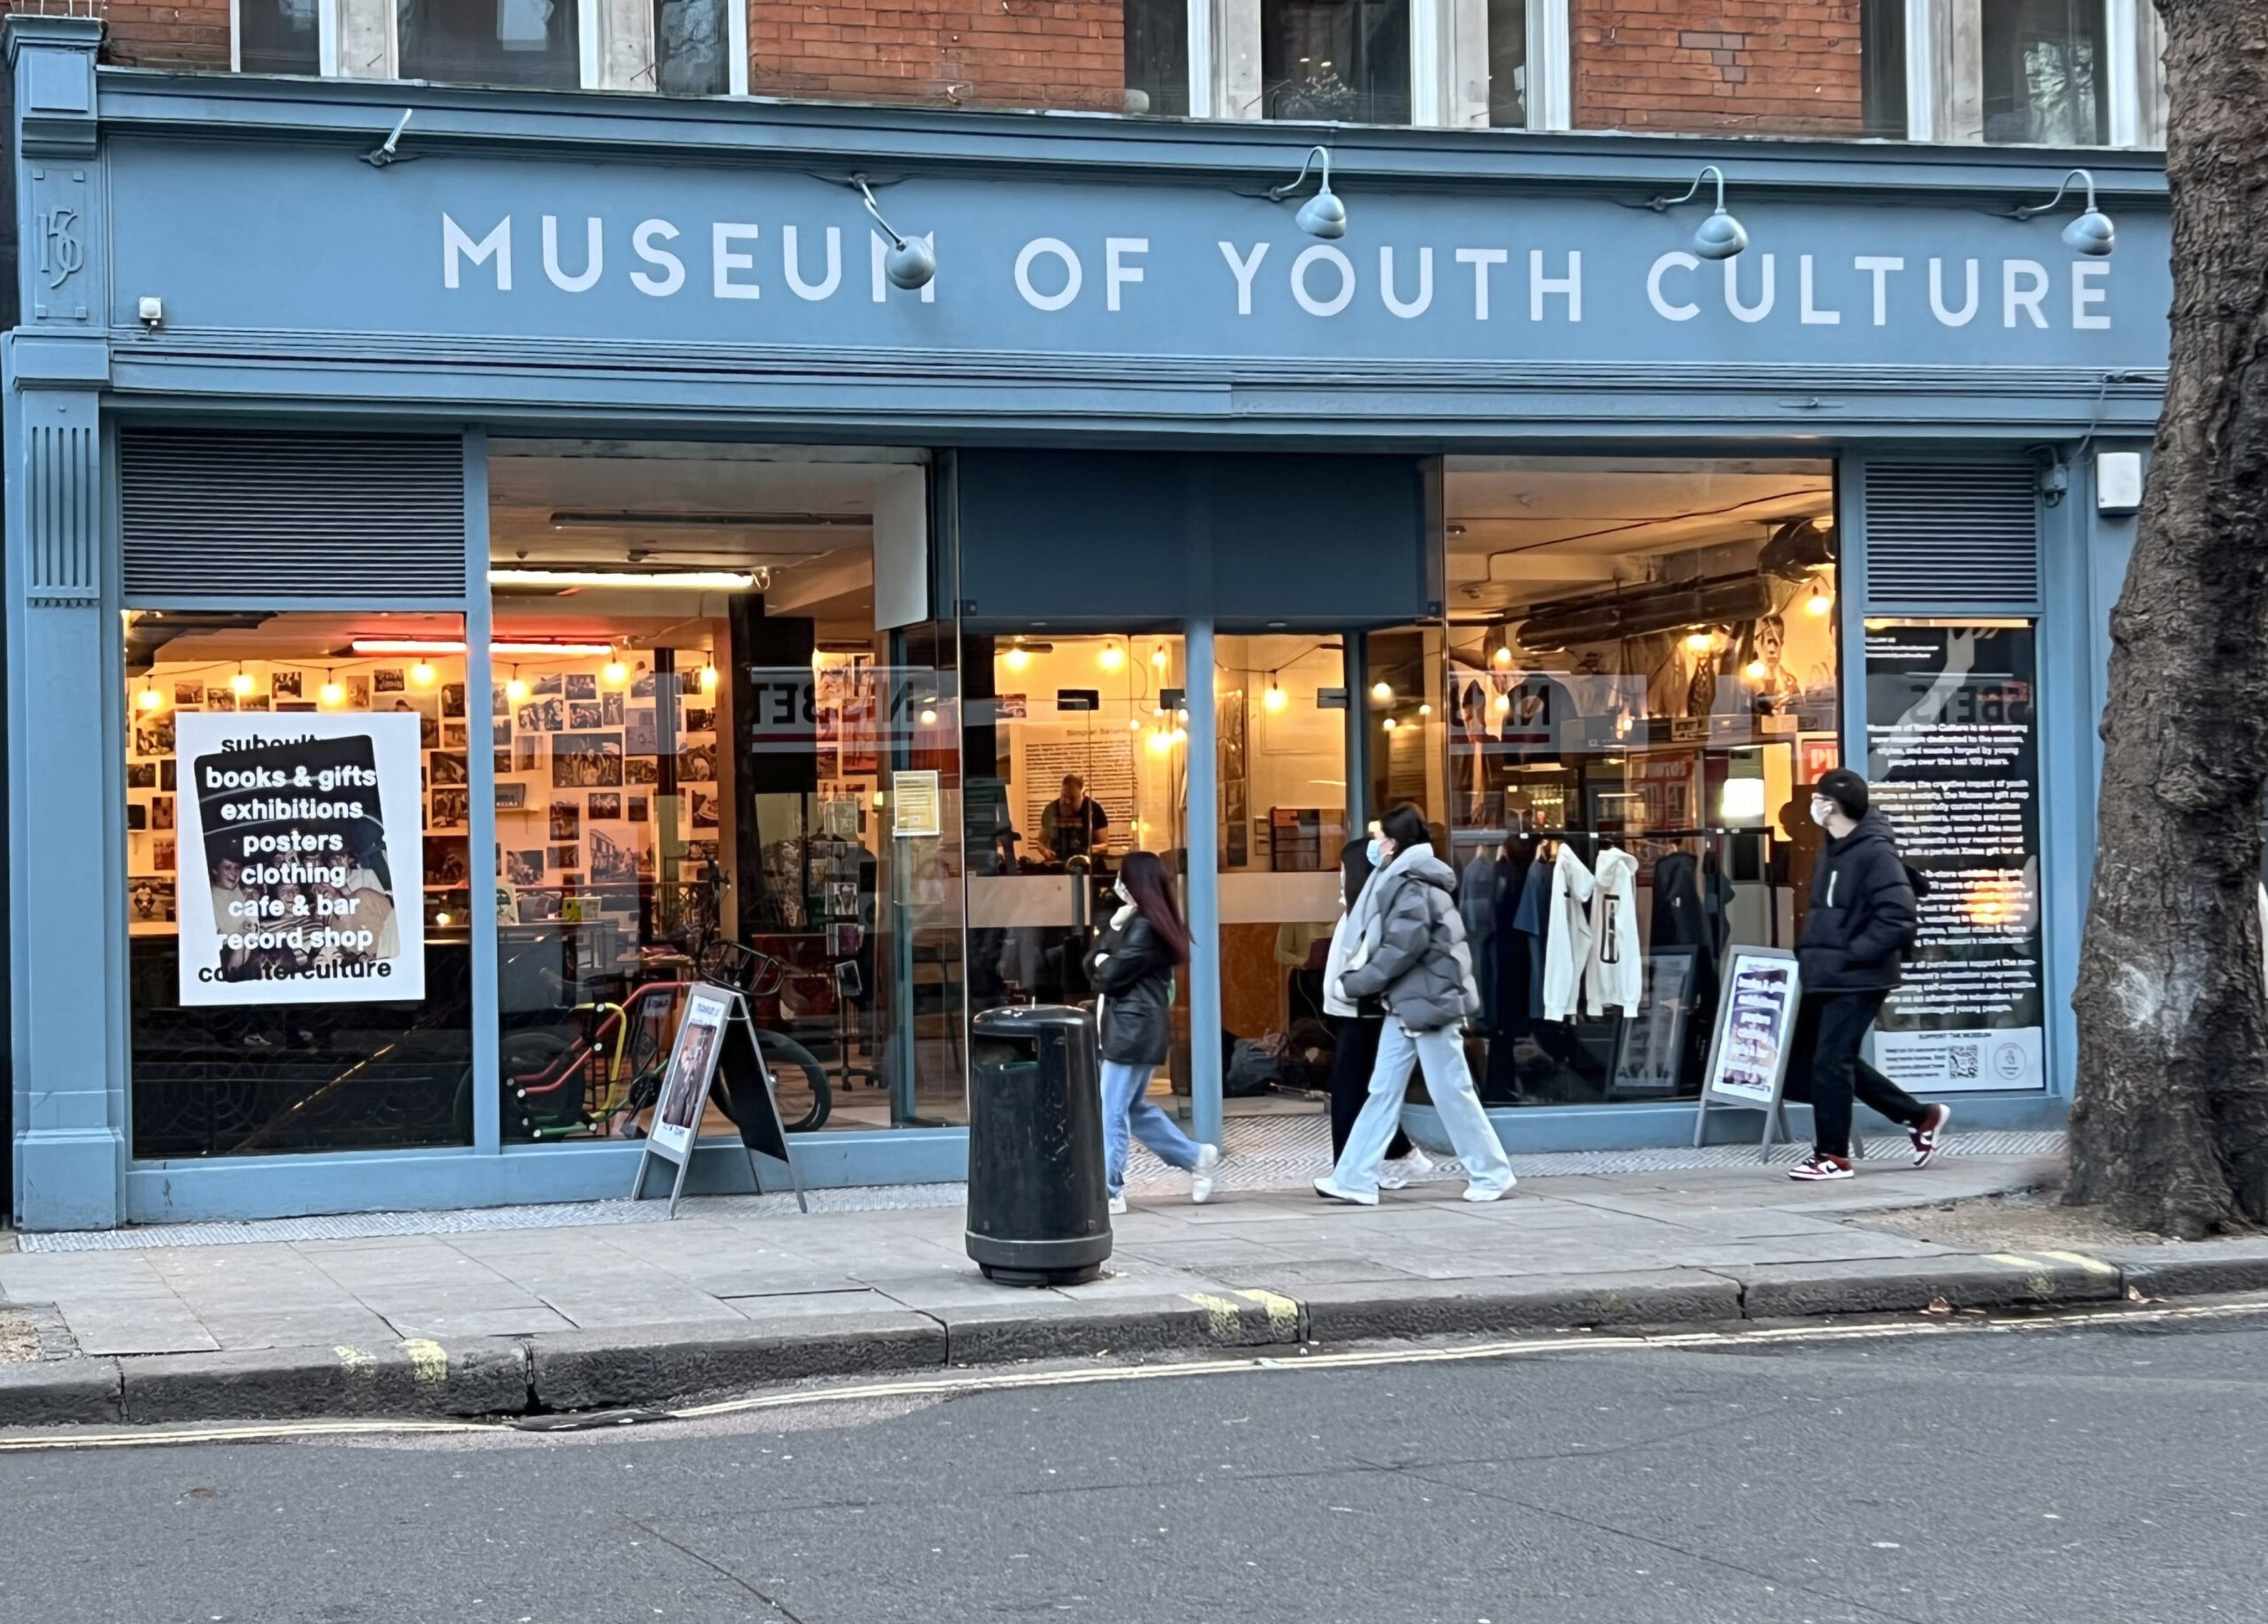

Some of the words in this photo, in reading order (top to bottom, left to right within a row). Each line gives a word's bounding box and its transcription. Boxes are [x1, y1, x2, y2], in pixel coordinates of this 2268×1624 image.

[444, 213, 935, 302] MUSEUM
[1015, 238, 1148, 311] OF
[1218, 242, 1581, 321] YOUTH
[1647, 252, 2111, 329] CULTURE
[206, 766, 286, 789] books
[292, 765, 311, 788] &
[318, 765, 376, 792] gifts
[220, 798, 364, 821] exhibitions
[243, 829, 343, 857] posters
[241, 863, 347, 887] clothing
[228, 896, 285, 917] cafe
[292, 895, 310, 917] &
[317, 895, 361, 916] bar
[217, 927, 302, 950] record
[310, 926, 373, 951] shop
